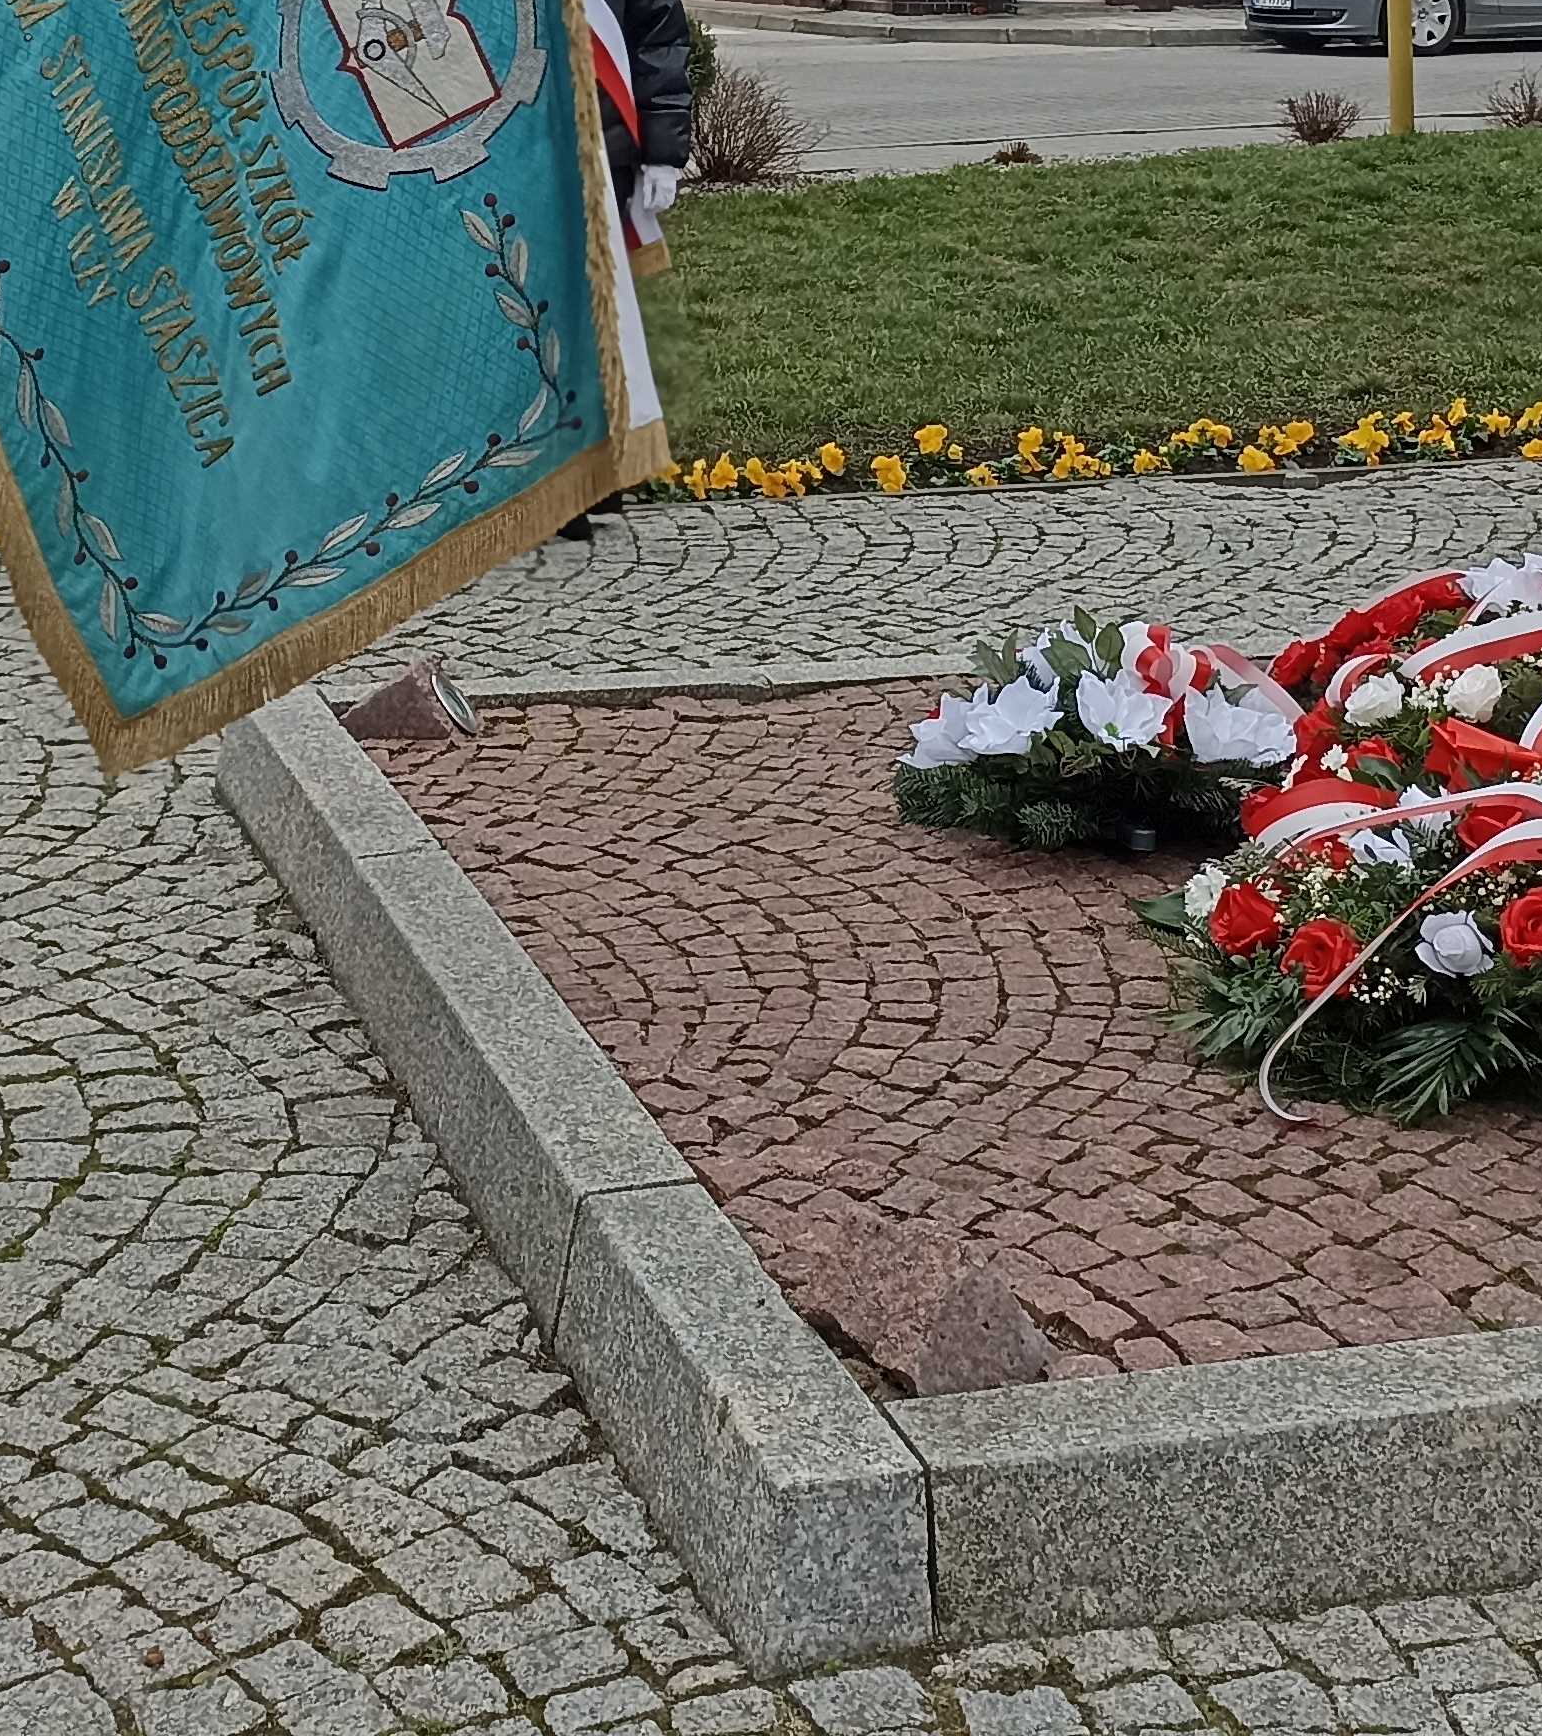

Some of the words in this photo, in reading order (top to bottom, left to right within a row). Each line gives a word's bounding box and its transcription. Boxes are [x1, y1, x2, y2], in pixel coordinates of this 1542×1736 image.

[39, 33, 155, 273] STANISŁAWA
[126, 264, 235, 469] STASZICA
[51, 174, 85, 222] W
[239, 133, 315, 276] SZKÓŁ
[67, 222, 118, 309] IŁŻY
